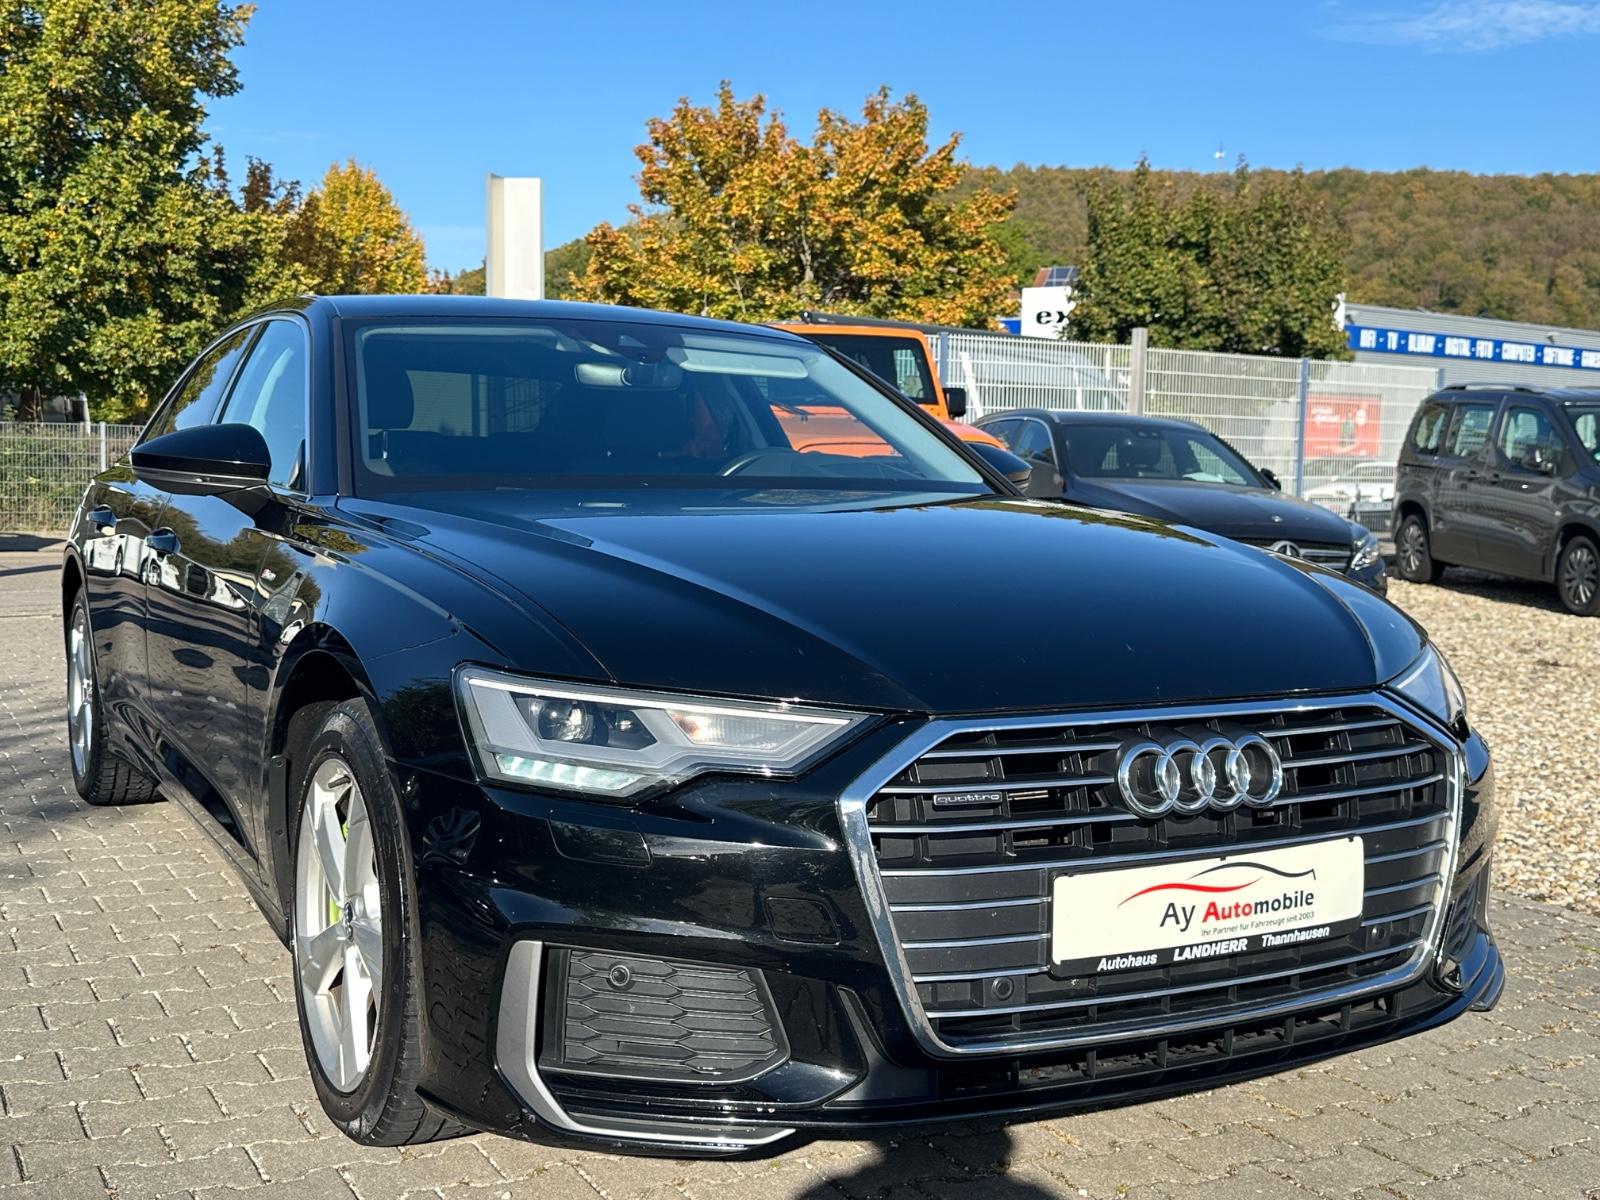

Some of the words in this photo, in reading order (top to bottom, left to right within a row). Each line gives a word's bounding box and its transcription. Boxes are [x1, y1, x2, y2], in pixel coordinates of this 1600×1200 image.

[1387, 331, 1398, 351] TV
[1501, 342, 1536, 363] COMPUTER
[937, 794, 1000, 804] quattro
[1160, 902, 1196, 932] Ay
[1202, 890, 1314, 923] Automobile
[1201, 928, 1212, 937] Ihr
[1213, 926, 1239, 935] Partner
[1240, 921, 1250, 931] für
[1251, 917, 1285, 929] Fahrzeuge
[1286, 914, 1298, 923] seit
[1299, 911, 1315, 921] 2003
[1097, 954, 1158, 971] Autohaus
[1173, 938, 1248, 961] LANDHERR
[1262, 926, 1330, 947] Thannhausen
